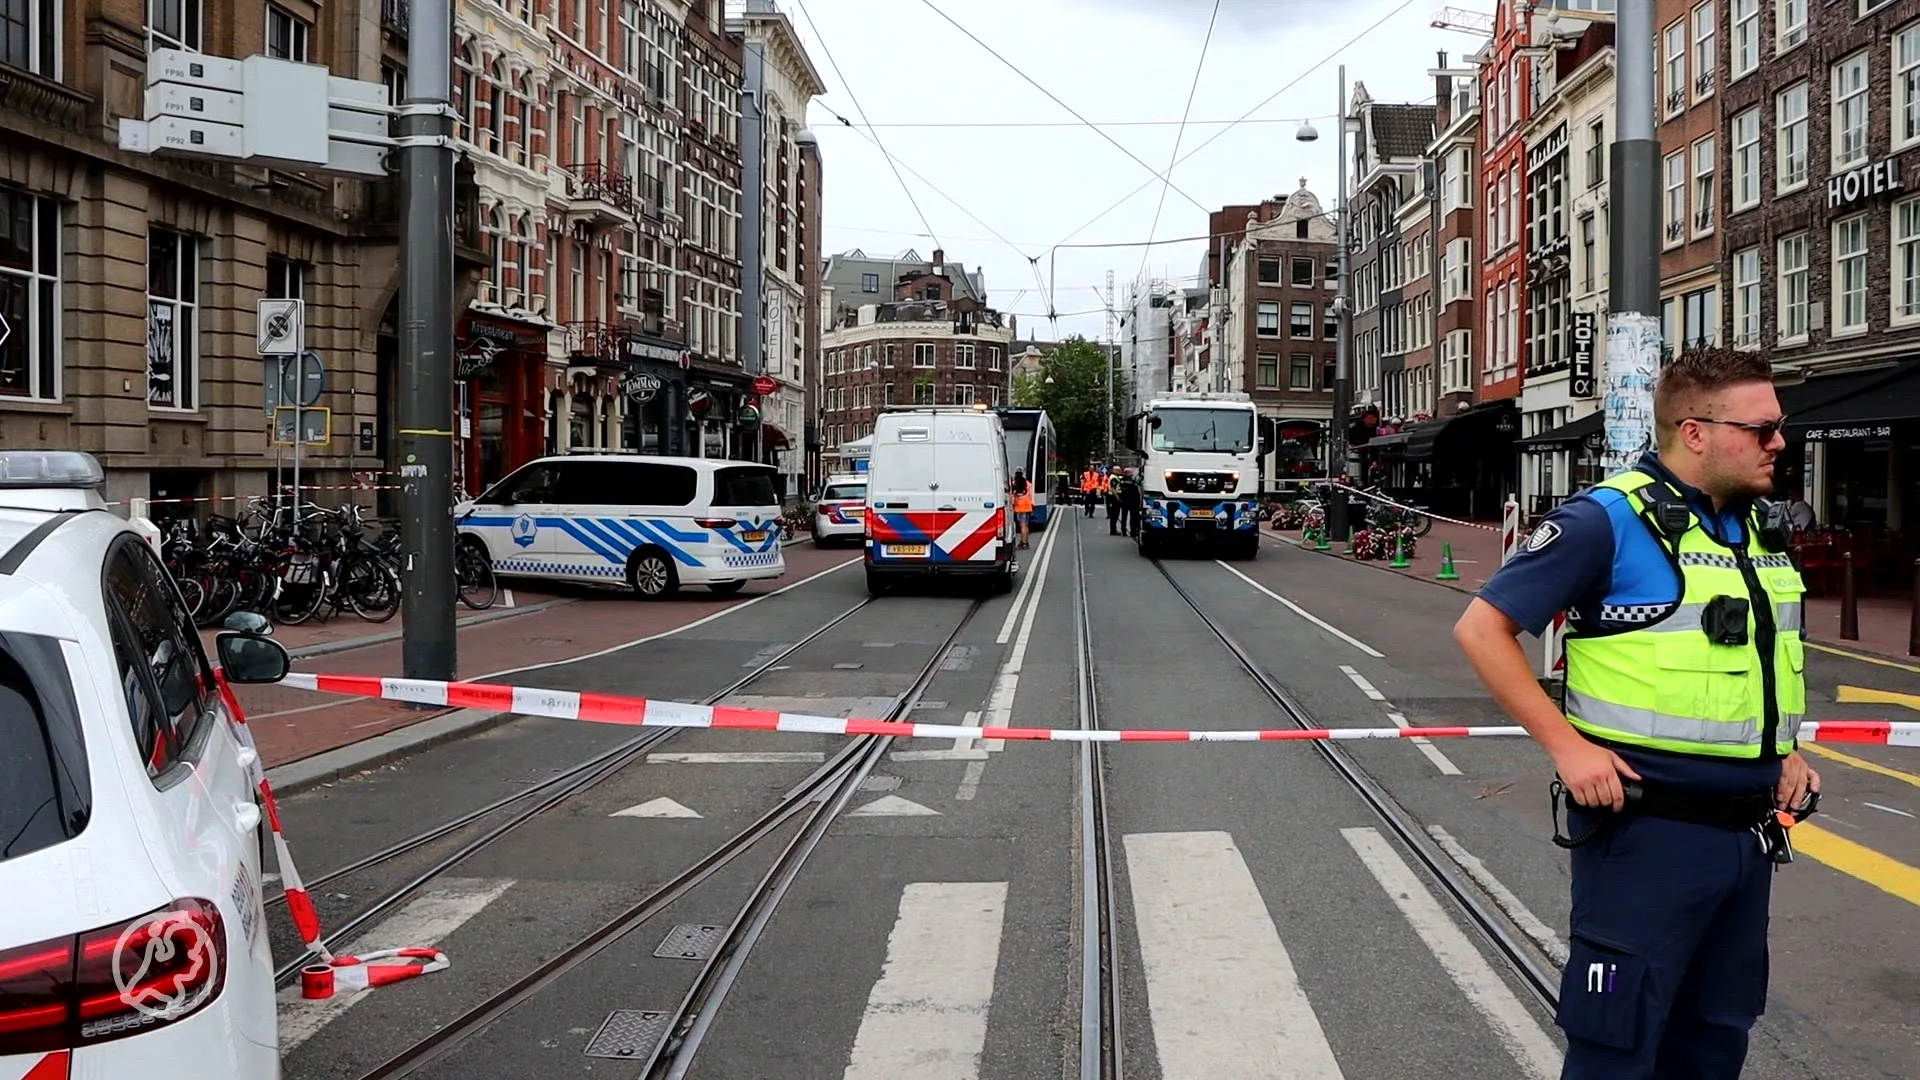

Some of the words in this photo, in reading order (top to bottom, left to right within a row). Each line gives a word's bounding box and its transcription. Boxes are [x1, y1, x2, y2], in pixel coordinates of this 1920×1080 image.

[165, 102, 185, 112] FP91
[165, 136, 185, 145] FP92
[1828, 158, 1898, 209] HOTEL
[769, 293, 780, 360] HOTEL
[1575, 315, 1592, 376] HOTEL
[1805, 429, 1824, 439] CAFE
[1828, 427, 1871, 439] RESTAURANT
[1877, 426, 1891, 437] BAR
[1186, 477, 1218, 486] MAN
